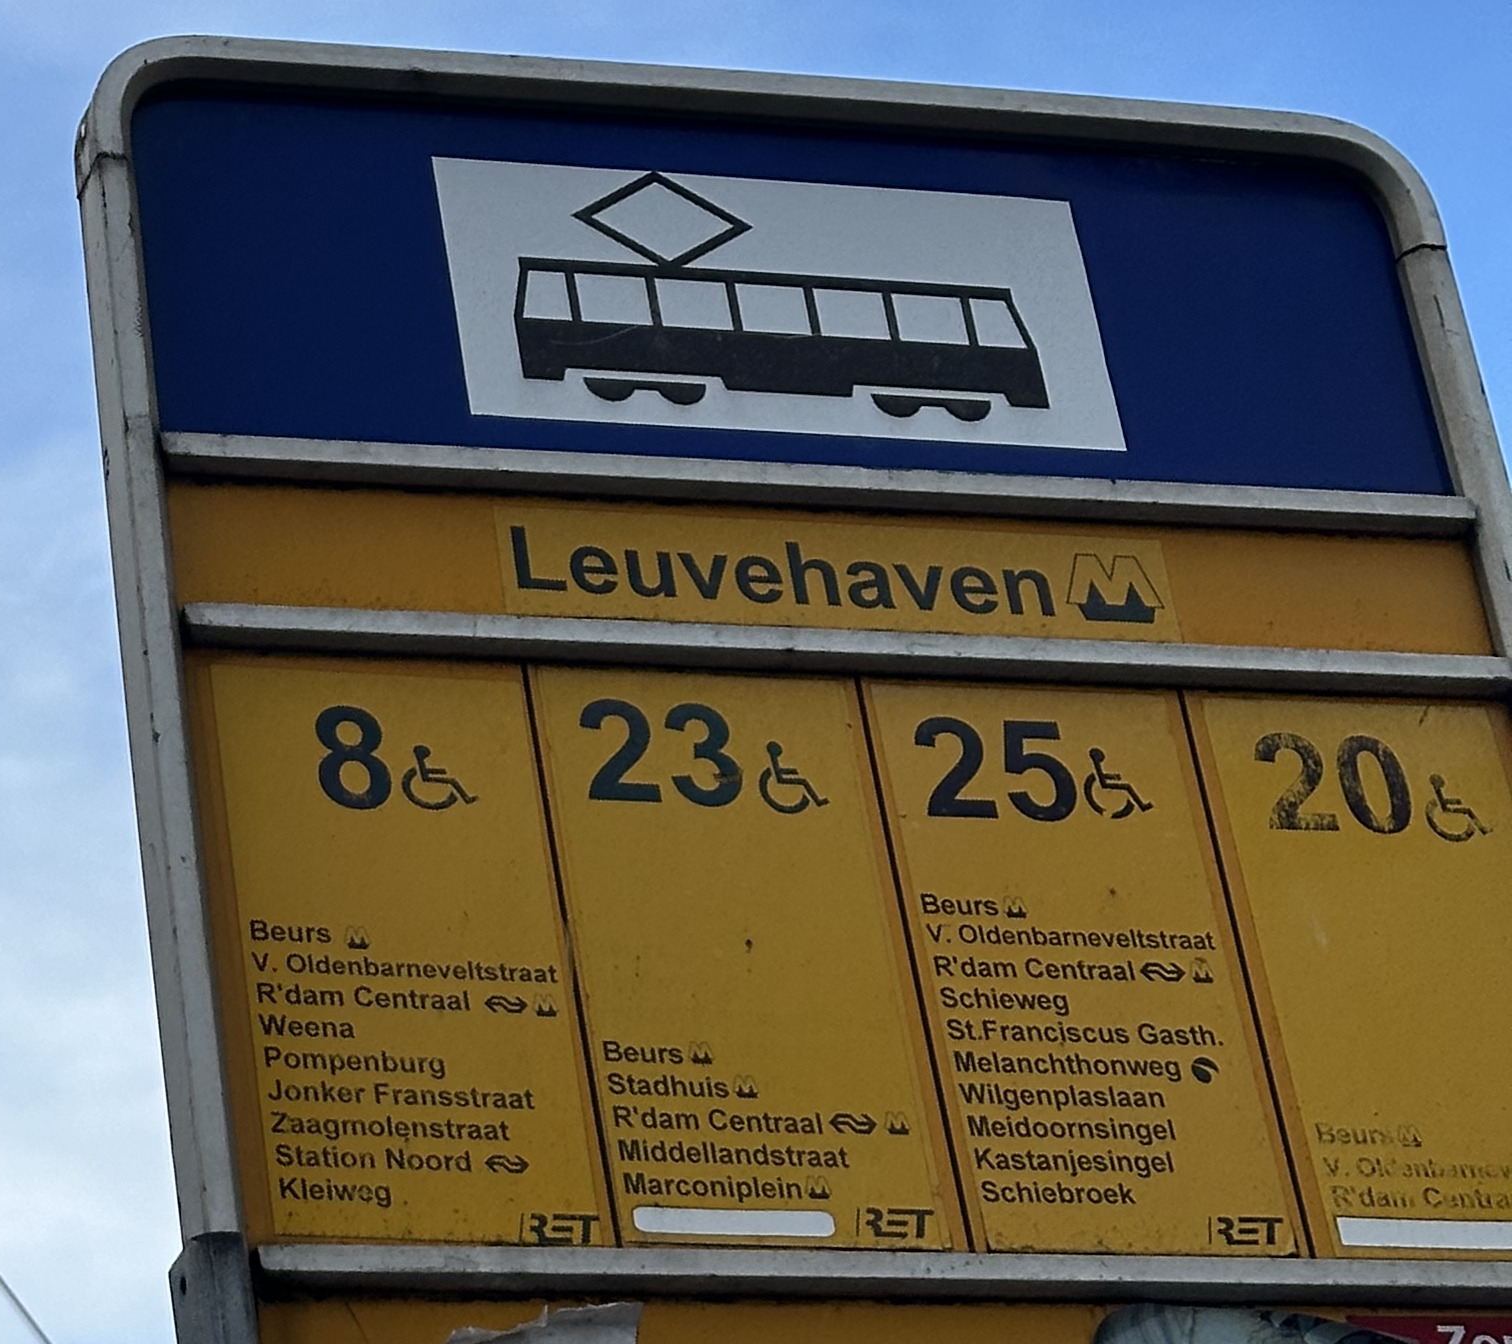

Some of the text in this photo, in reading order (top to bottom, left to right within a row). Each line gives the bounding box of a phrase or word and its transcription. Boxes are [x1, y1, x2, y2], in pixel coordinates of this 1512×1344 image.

[510, 524, 1057, 619] Leuvehaven
[314, 704, 393, 811] 8
[578, 697, 744, 809] 23
[913, 716, 1078, 824] 25
[1252, 731, 1412, 837] 20
[920, 892, 999, 917] Beurs
[249, 919, 333, 945] Beurs
[925, 923, 1217, 952] V. Oldenbarneveltstraat
[251, 952, 559, 985] V. Oldenbarneveltstraat
[933, 955, 1136, 983] R'dam Centraal
[256, 983, 471, 1012] R'dam Centraal
[939, 987, 1070, 1017] Schieweg
[258, 1013, 356, 1040] Weena
[1137, 1022, 1225, 1048] Gasth.
[263, 1046, 447, 1080] Pompenburg
[602, 1040, 684, 1065] Beurs
[952, 1050, 1182, 1084] Melanchthonweg
[267, 1079, 536, 1111] Jonker Fransstraat
[606, 1073, 730, 1100] Stadhuis
[959, 1082, 1166, 1112] Wilgenplaslaan
[270, 1112, 511, 1143] Zaagmolenstraat
[612, 1105, 824, 1135] R'dam Centraal
[966, 1114, 1177, 1147] Meidoornsingel
[274, 1143, 472, 1173] Station Noord
[617, 1139, 850, 1169] Middellandstraat
[972, 1147, 1176, 1179] Kastanjesingel
[278, 1177, 393, 1208] Kleiweg
[623, 1171, 803, 1203] Marconiplein
[980, 1180, 1137, 1206] Schiebroek
[529, 1212, 600, 1245] RET
[865, 1206, 935, 1240] RET
[1217, 1216, 1284, 1246] RET
